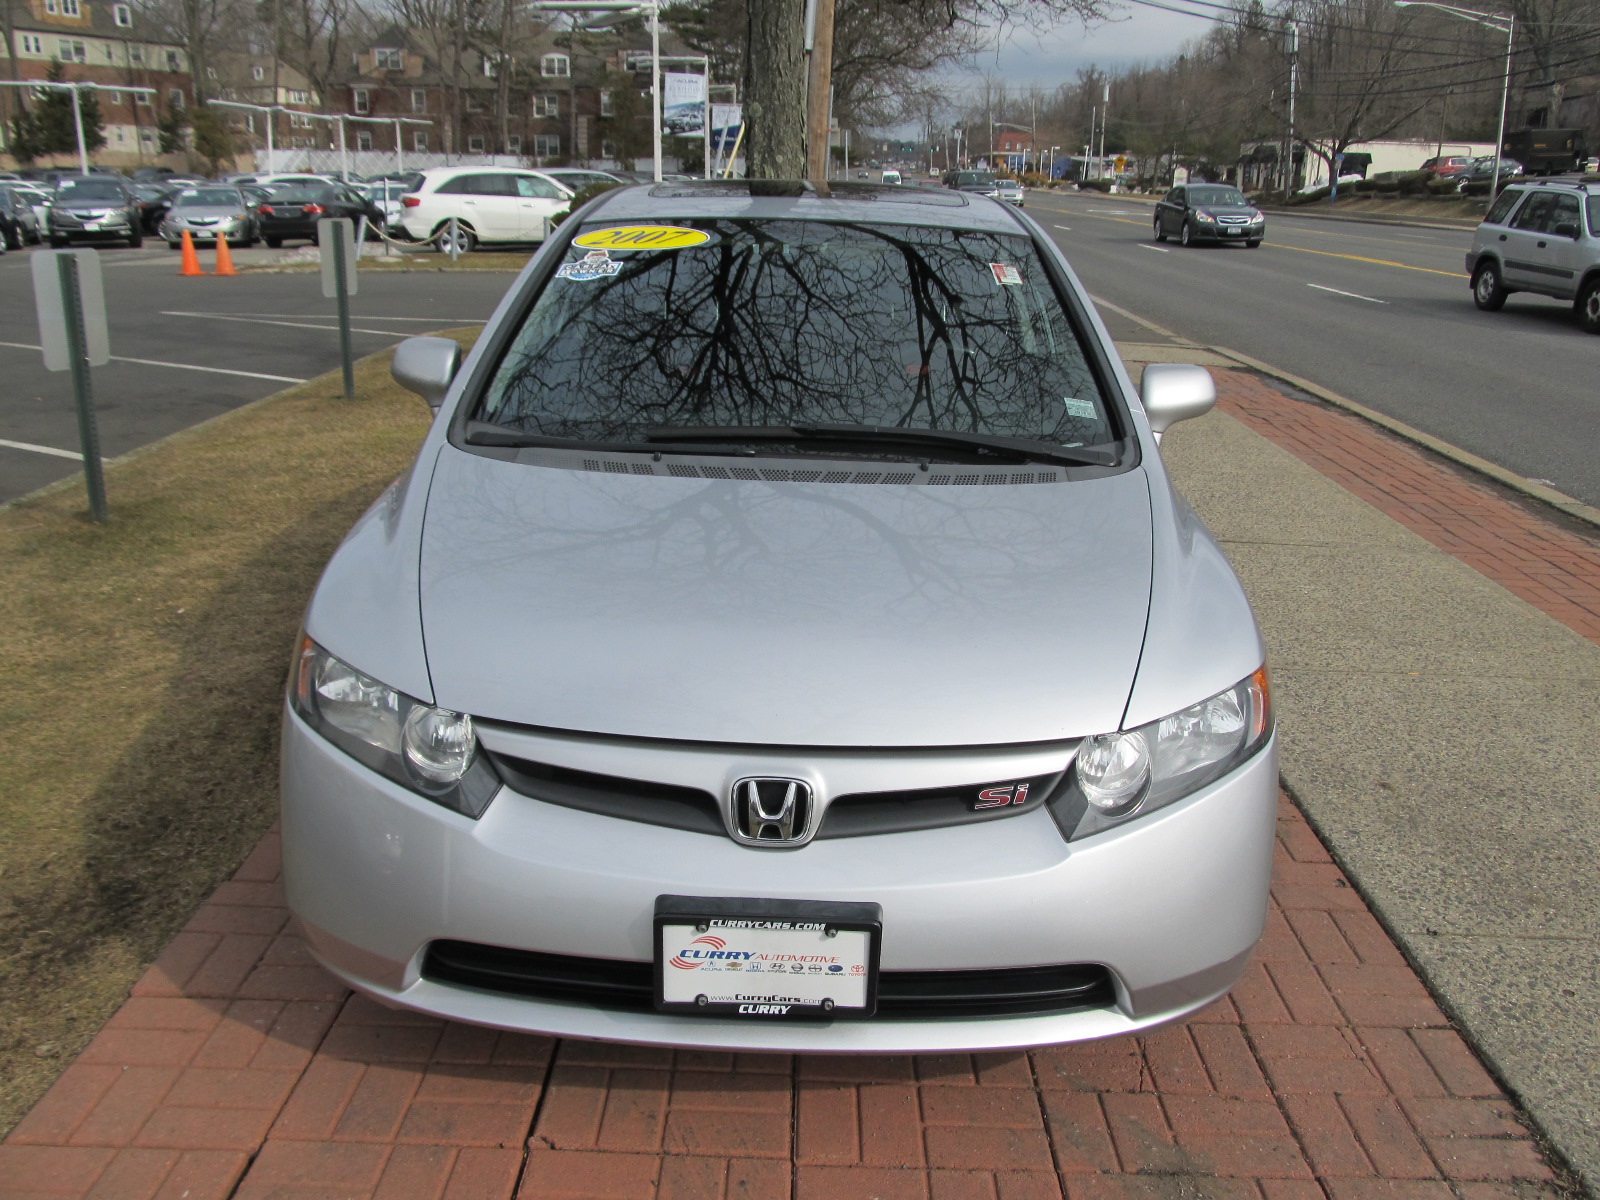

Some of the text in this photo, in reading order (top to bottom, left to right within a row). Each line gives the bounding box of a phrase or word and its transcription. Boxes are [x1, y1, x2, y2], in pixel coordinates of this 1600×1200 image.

[586, 230, 693, 244] 2007
[975, 783, 1029, 809] Si
[709, 919, 827, 931] CURRYCARS.COM
[679, 949, 841, 964] CURRY AUTOMOTIVE
[738, 1004, 792, 1015] CURRY
